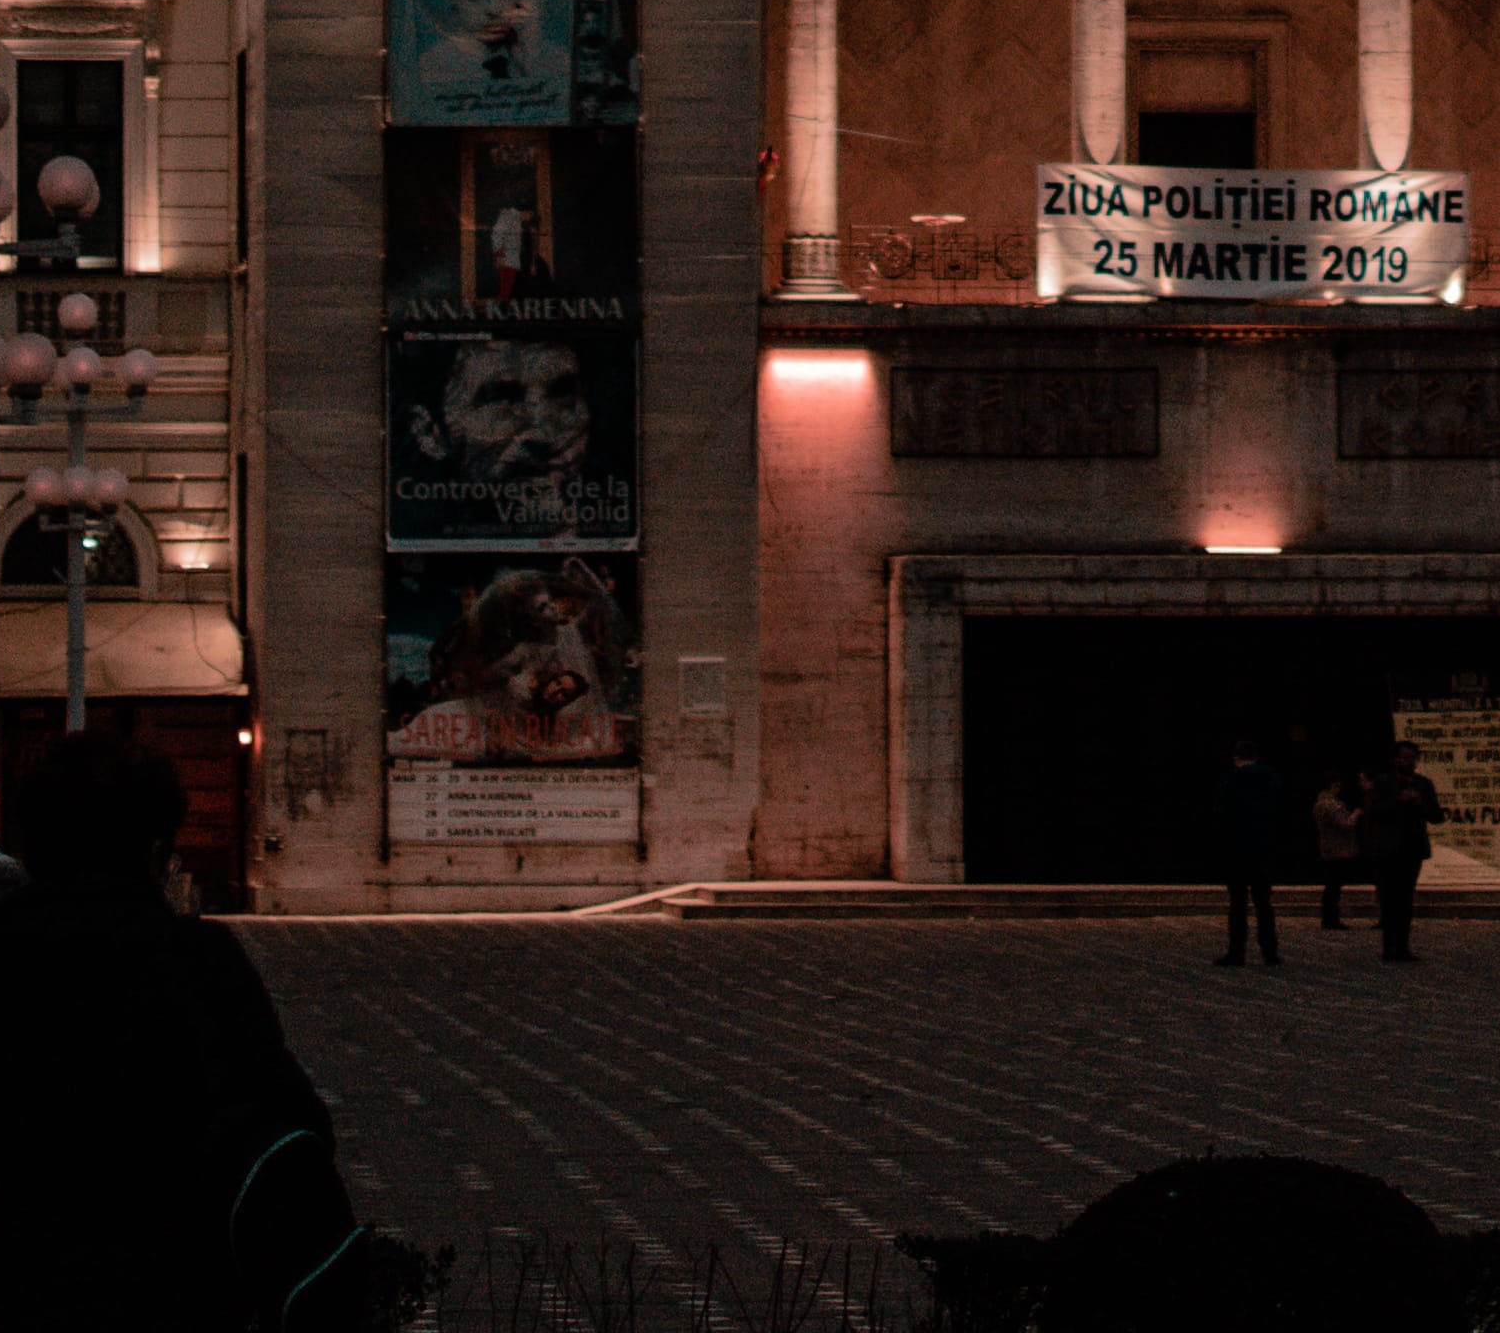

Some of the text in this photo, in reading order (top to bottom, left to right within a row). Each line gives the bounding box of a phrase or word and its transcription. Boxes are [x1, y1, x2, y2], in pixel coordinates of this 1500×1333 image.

[1094, 240, 1136, 277] 25
[1322, 246, 1408, 283] 2019
[403, 295, 625, 321] ANNA KARENINA
[395, 473, 631, 501] Controversa de la
[495, 499, 631, 524] Valladolid
[400, 712, 484, 749] SAREA
